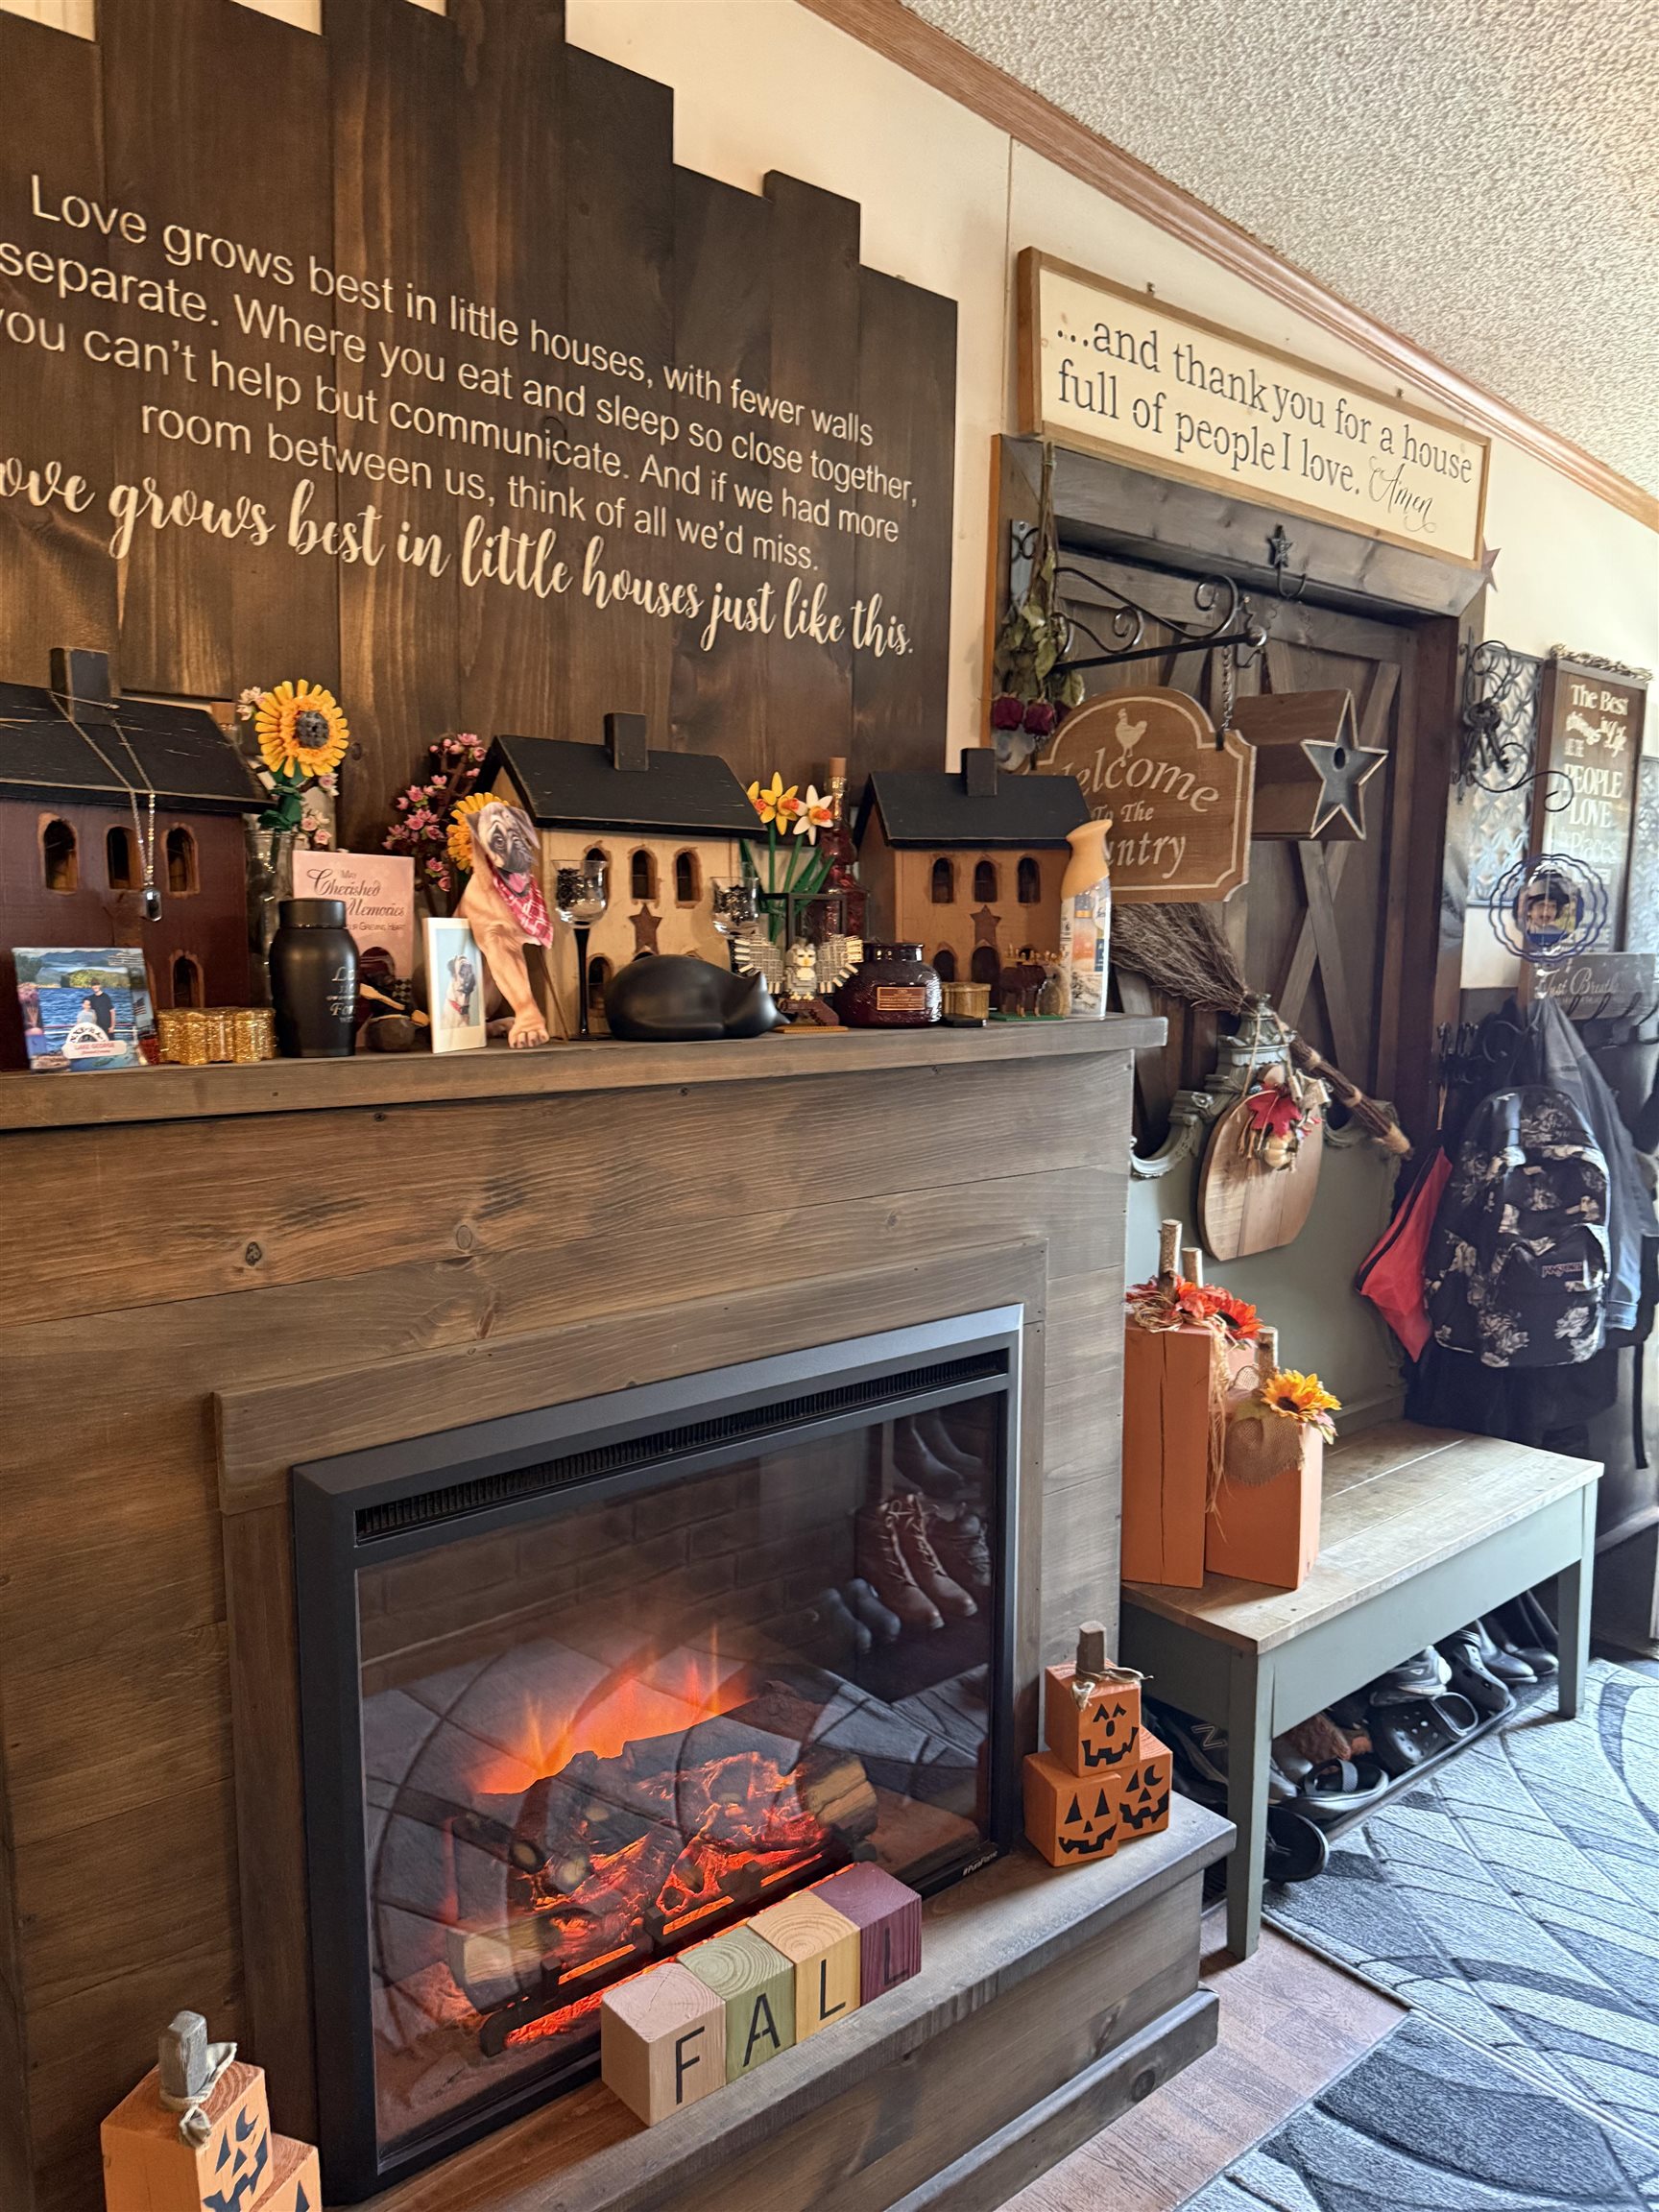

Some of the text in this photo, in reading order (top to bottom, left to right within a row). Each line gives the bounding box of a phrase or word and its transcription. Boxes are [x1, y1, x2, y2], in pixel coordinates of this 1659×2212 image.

[32, 175, 874, 446] Love grows best in little houses, with fewer walls
[0, 242, 918, 509] separate. Where you eat and sleep so close together,
[1056, 322, 1161, 373] ...and
[1336, 397, 1372, 444] for
[1380, 426, 1395, 454] a
[1403, 424, 1473, 484] house
[142, 404, 252, 454] room
[267, 423, 432, 491] between
[445, 469, 496, 507] us,
[508, 474, 586, 521] think
[595, 497, 626, 529] of
[634, 506, 667, 538] all
[754, 537, 820, 572] miss.
[211, 349, 301, 412] help
[316, 375, 378, 425] but
[389, 401, 630, 480] communicate.
[639, 453, 701, 496] And
[710, 470, 728, 504] if
[733, 480, 774, 515] we
[781, 487, 830, 529] had
[837, 508, 899, 543] more
[1058, 358, 1437, 534] full of people I love. Amen
[0, 457, 914, 658] ove grows best in little houses just like this.
[1571, 684, 1629, 716] The Best
[1052, 747, 1219, 812] elcome
[1120, 800, 1154, 823] The
[1564, 763, 1623, 799] PEOPLE
[1569, 797, 1612, 828] LOVE
[306, 868, 381, 897] Cherished
[347, 898, 404, 916] Memories
